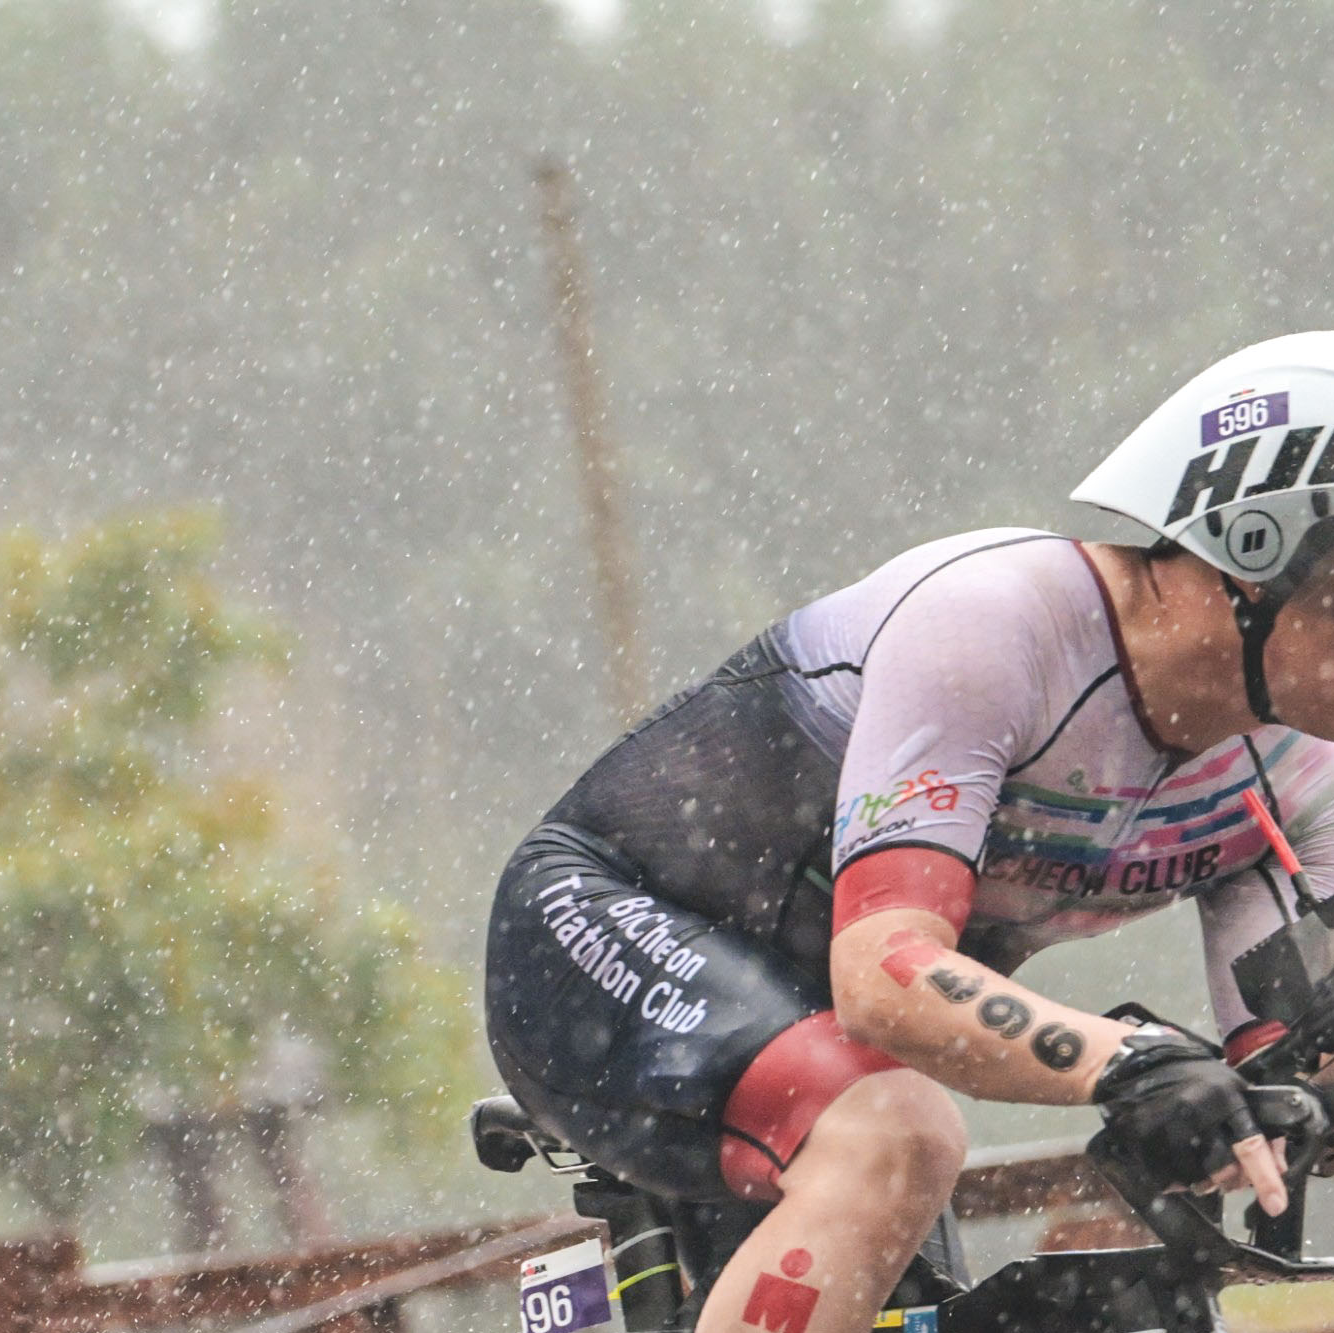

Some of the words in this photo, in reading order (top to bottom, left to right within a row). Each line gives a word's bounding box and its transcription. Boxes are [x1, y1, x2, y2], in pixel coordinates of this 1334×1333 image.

[1218, 398, 1269, 436] 596
[1119, 843, 1221, 896] CLUB
[538, 874, 642, 1005] Triathlon
[641, 981, 708, 1034] Club
